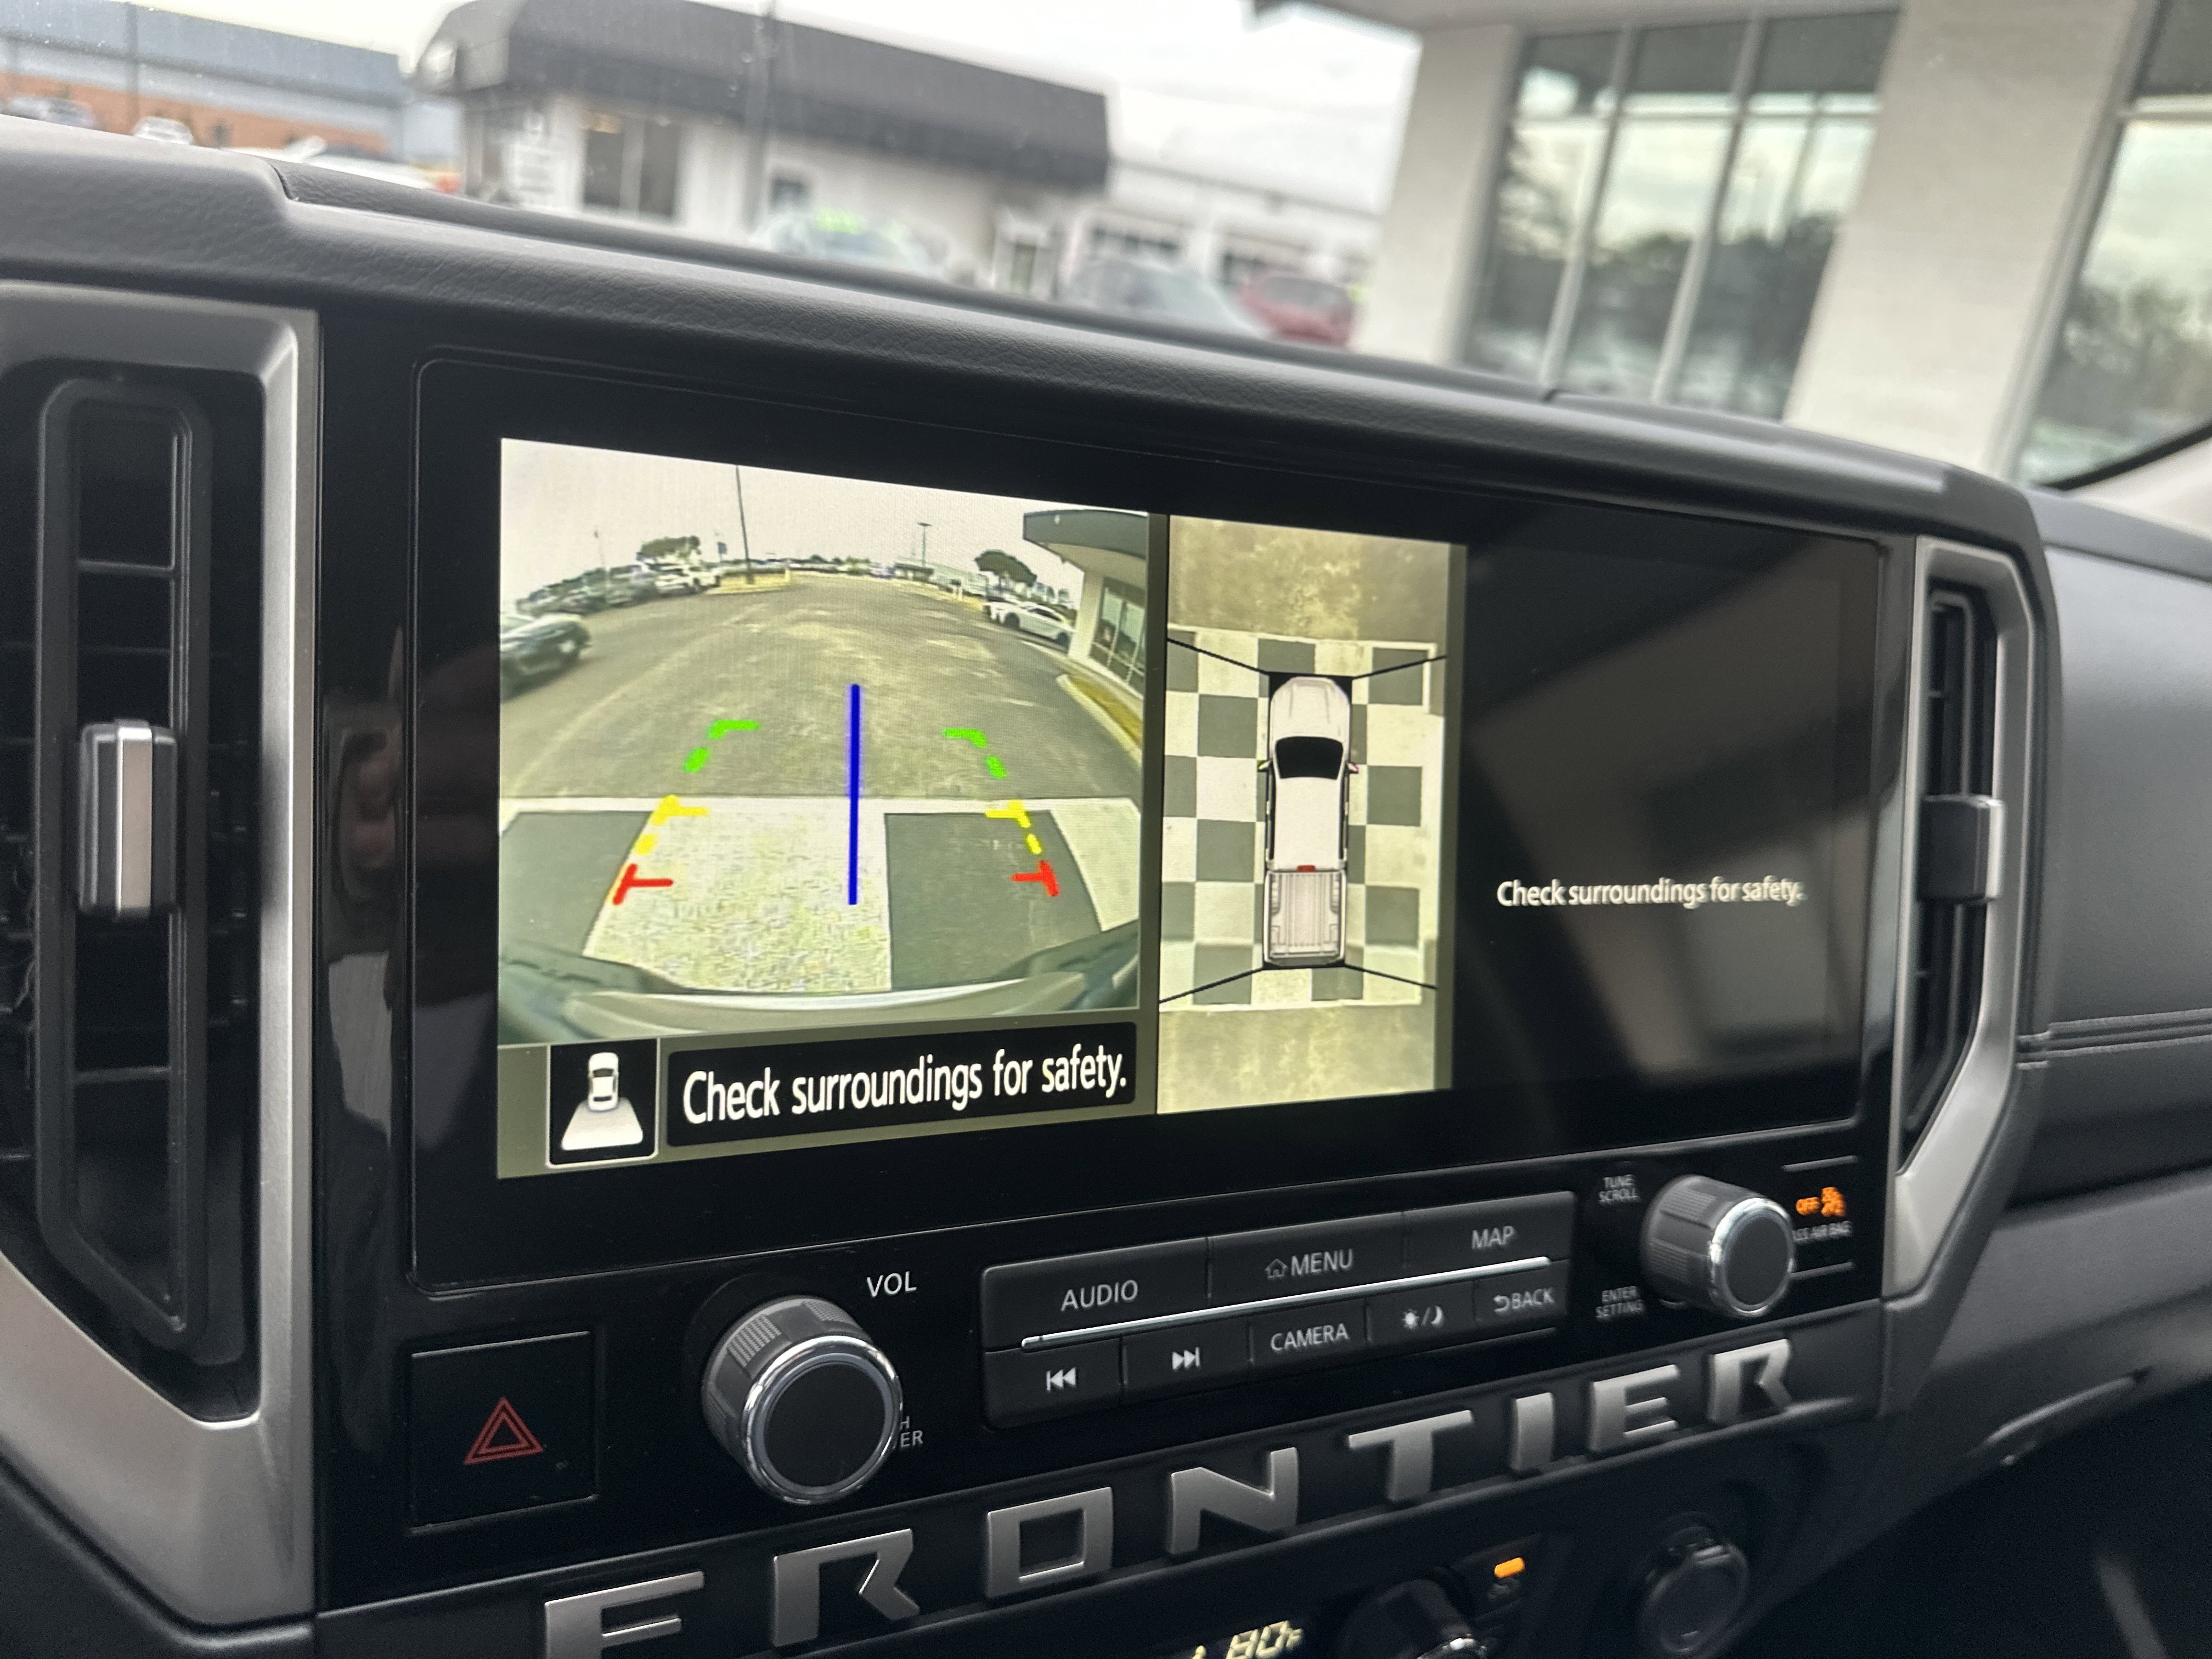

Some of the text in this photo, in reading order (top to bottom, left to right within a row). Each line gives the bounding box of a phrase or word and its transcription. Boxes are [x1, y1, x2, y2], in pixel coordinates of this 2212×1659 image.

[1496, 874, 1807, 910] Check surroundings for safety.
[683, 1043, 1126, 1124] Check surroundings for safety.
[1603, 1174, 1635, 1189] TUNE
[1598, 1187, 1640, 1205] SCROLL
[1471, 1225, 1516, 1250] MAP
[1291, 1249, 1353, 1276] MENU
[866, 1271, 917, 1297] VOL
[1060, 1279, 1138, 1311] AUDIO
[1601, 1285, 1639, 1304] ENTER
[1511, 1288, 1556, 1308] BACK
[1596, 1299, 1644, 1319] SETTING
[1270, 1323, 1350, 1353] CAMERA
[545, 1339, 1792, 1659] FRONTIER
